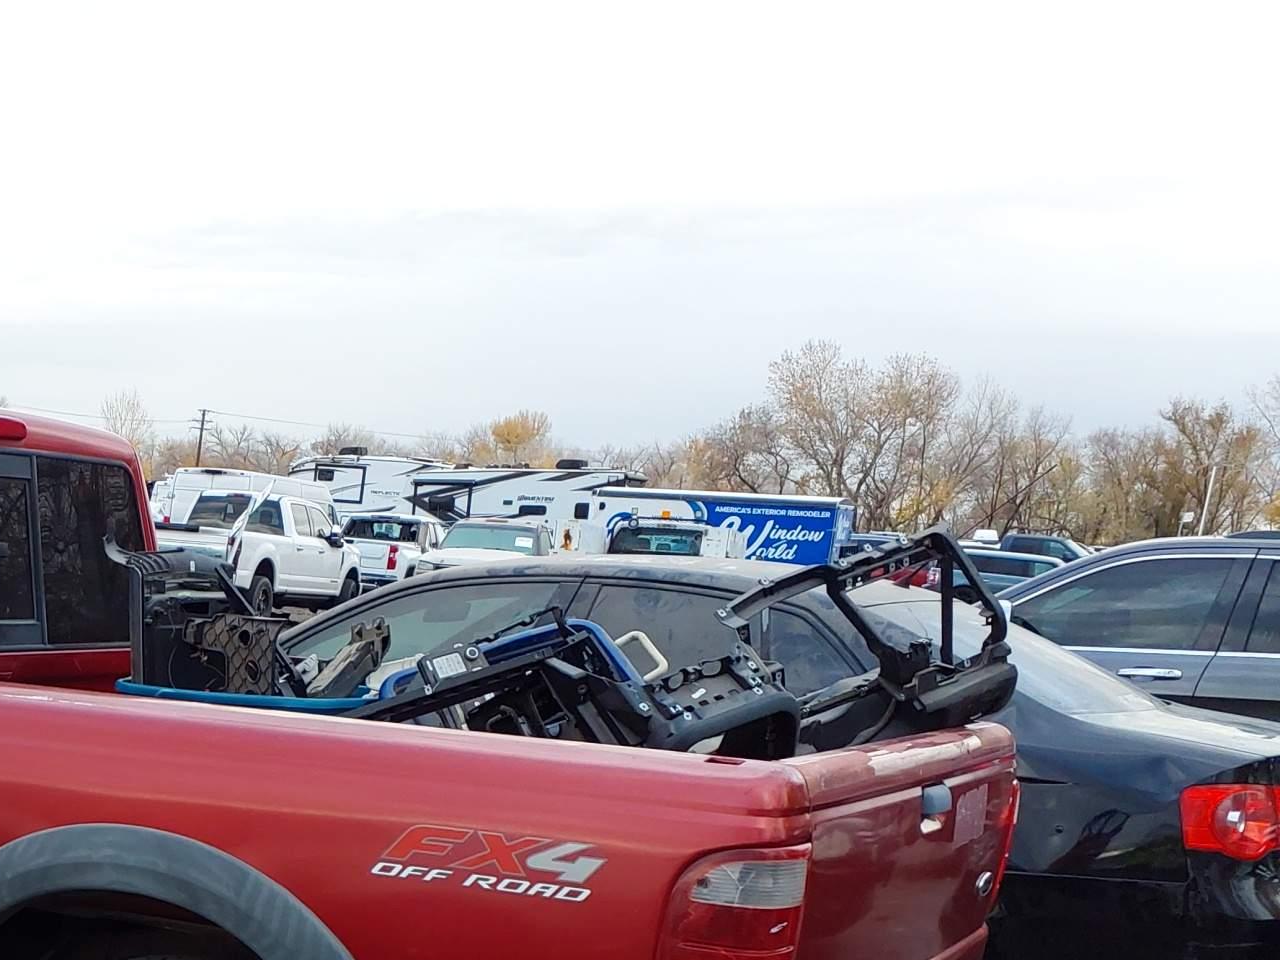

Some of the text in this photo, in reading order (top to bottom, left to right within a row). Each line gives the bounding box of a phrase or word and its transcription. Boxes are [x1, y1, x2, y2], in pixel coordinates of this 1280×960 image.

[714, 505, 831, 518] AMERICA'S EXTERIOR REMODELER
[720, 516, 824, 557] Window
[380, 823, 608, 885] FX4
[370, 861, 592, 902] OFF ROAD
